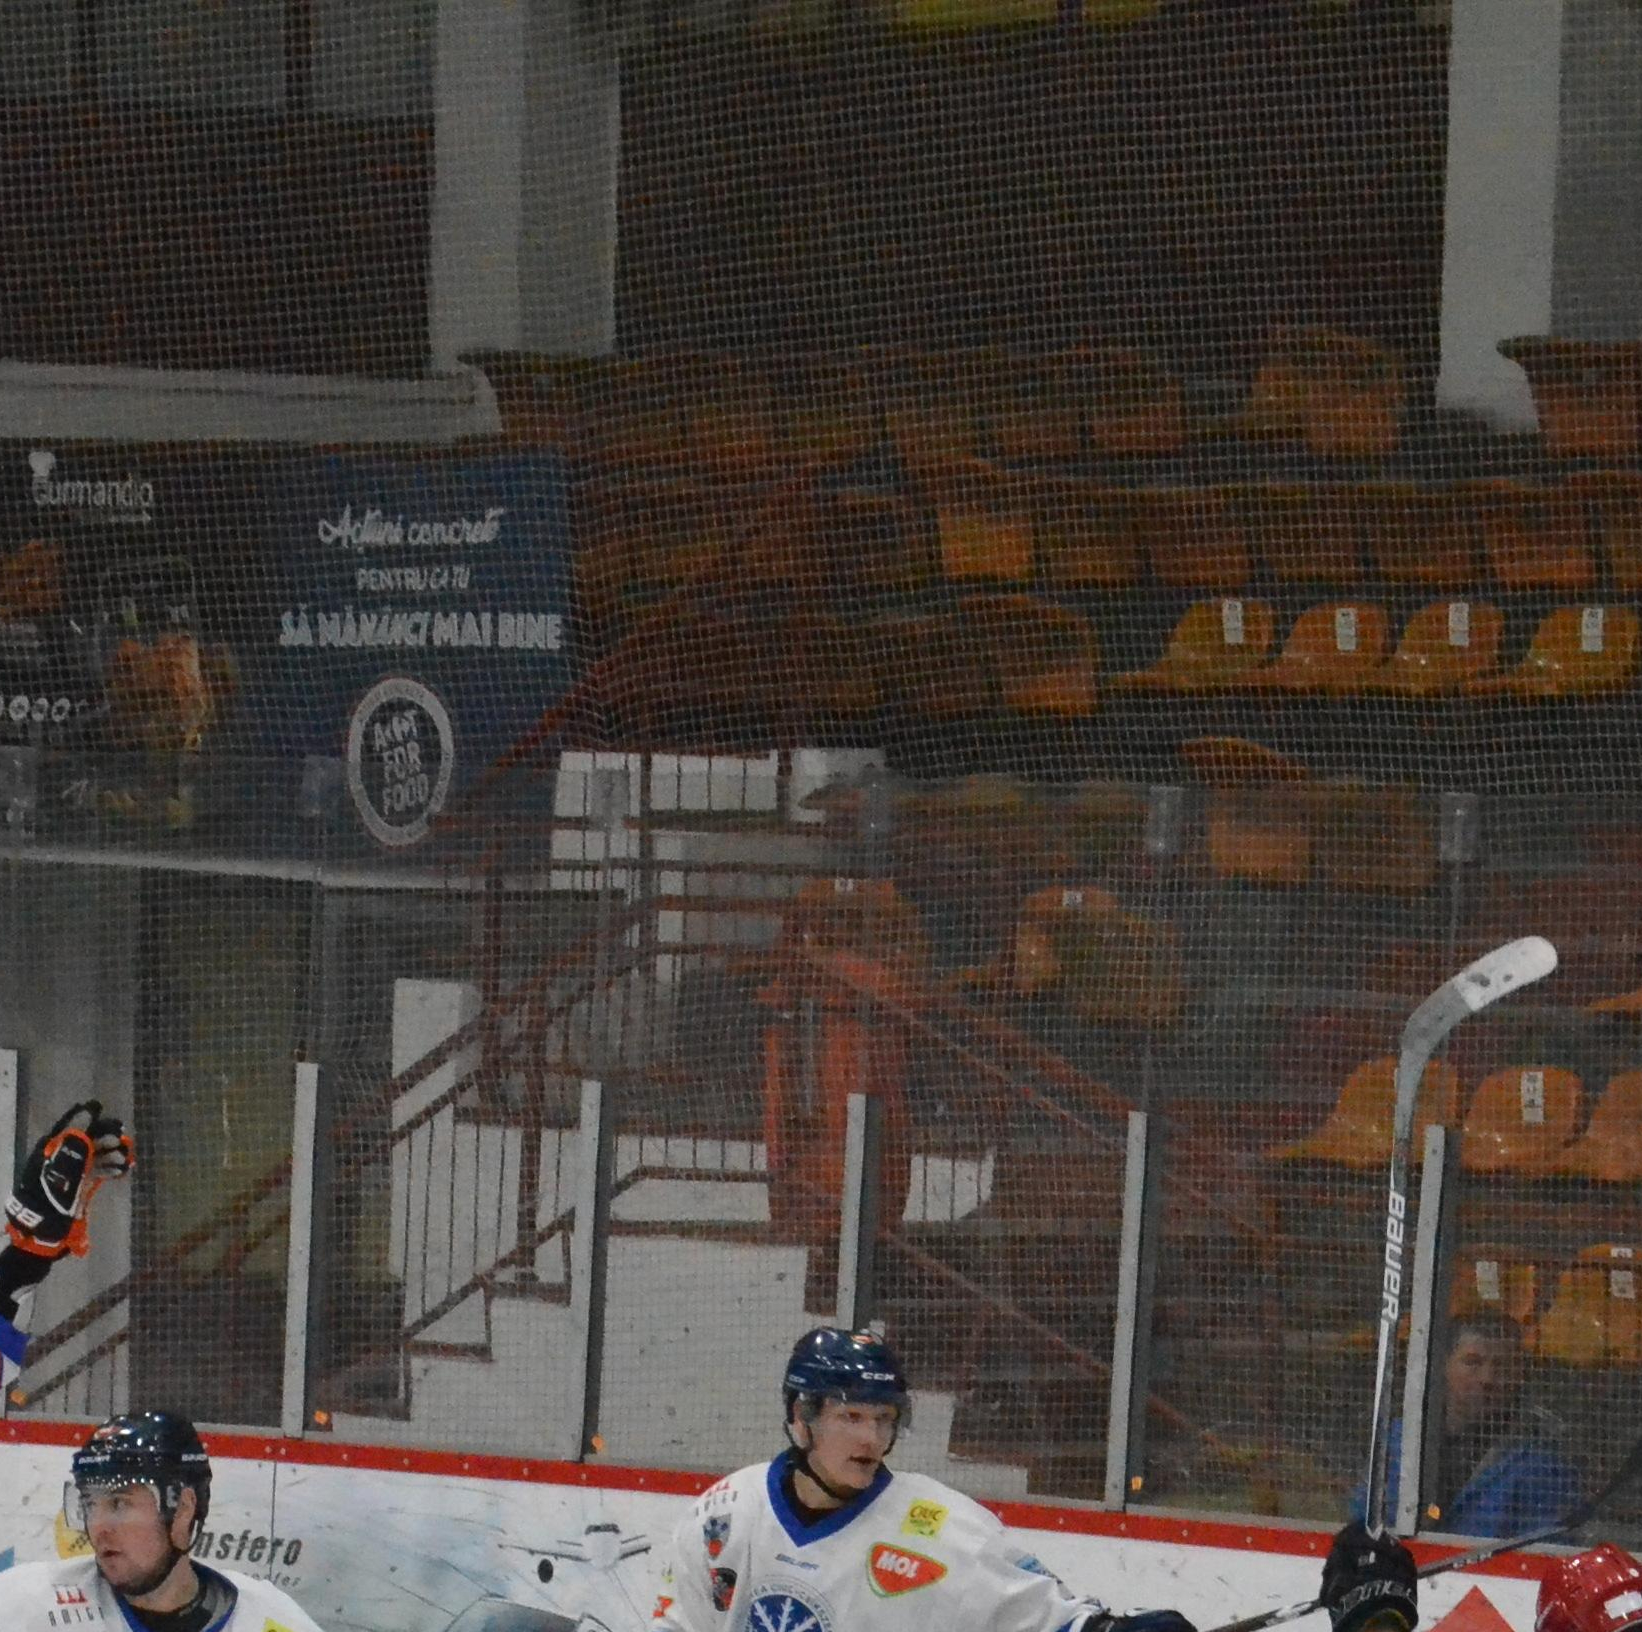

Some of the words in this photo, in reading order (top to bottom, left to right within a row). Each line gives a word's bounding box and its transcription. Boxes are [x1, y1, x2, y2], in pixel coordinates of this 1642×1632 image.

[358, 566, 428, 590] PENTRU
[432, 611, 493, 646] MAI
[498, 612, 562, 649] BINE
[382, 741, 422, 783] FOR
[383, 773, 430, 816] FOOD
[193, 1528, 302, 1566] nsfero
[875, 1550, 920, 1579] MOL
